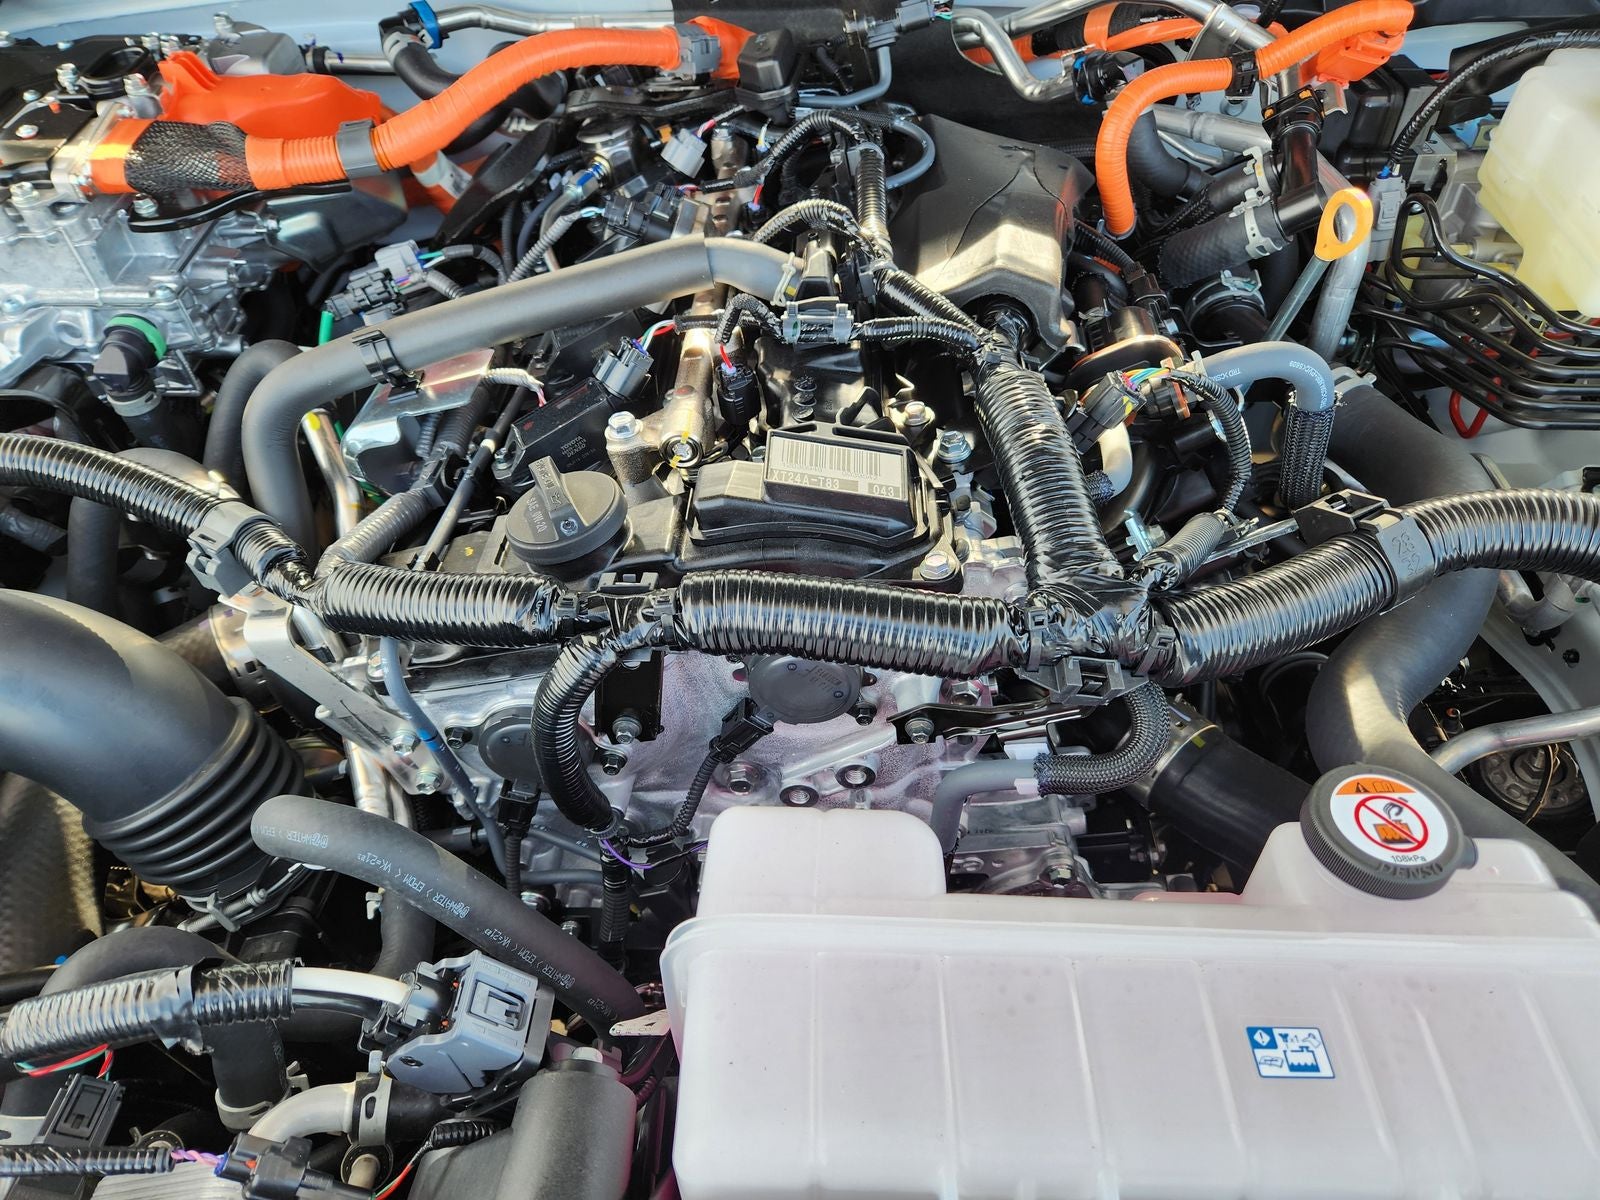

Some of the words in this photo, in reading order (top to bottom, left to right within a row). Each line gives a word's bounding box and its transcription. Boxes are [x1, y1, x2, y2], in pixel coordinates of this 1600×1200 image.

[560, 435, 584, 452] TOYOTA
[771, 469, 840, 490] XT24A-T83
[872, 484, 895, 498] 043
[526, 496, 538, 511] SAE
[1391, 854, 1428, 864] 108kPa
[1379, 862, 1444, 879] DENSO
